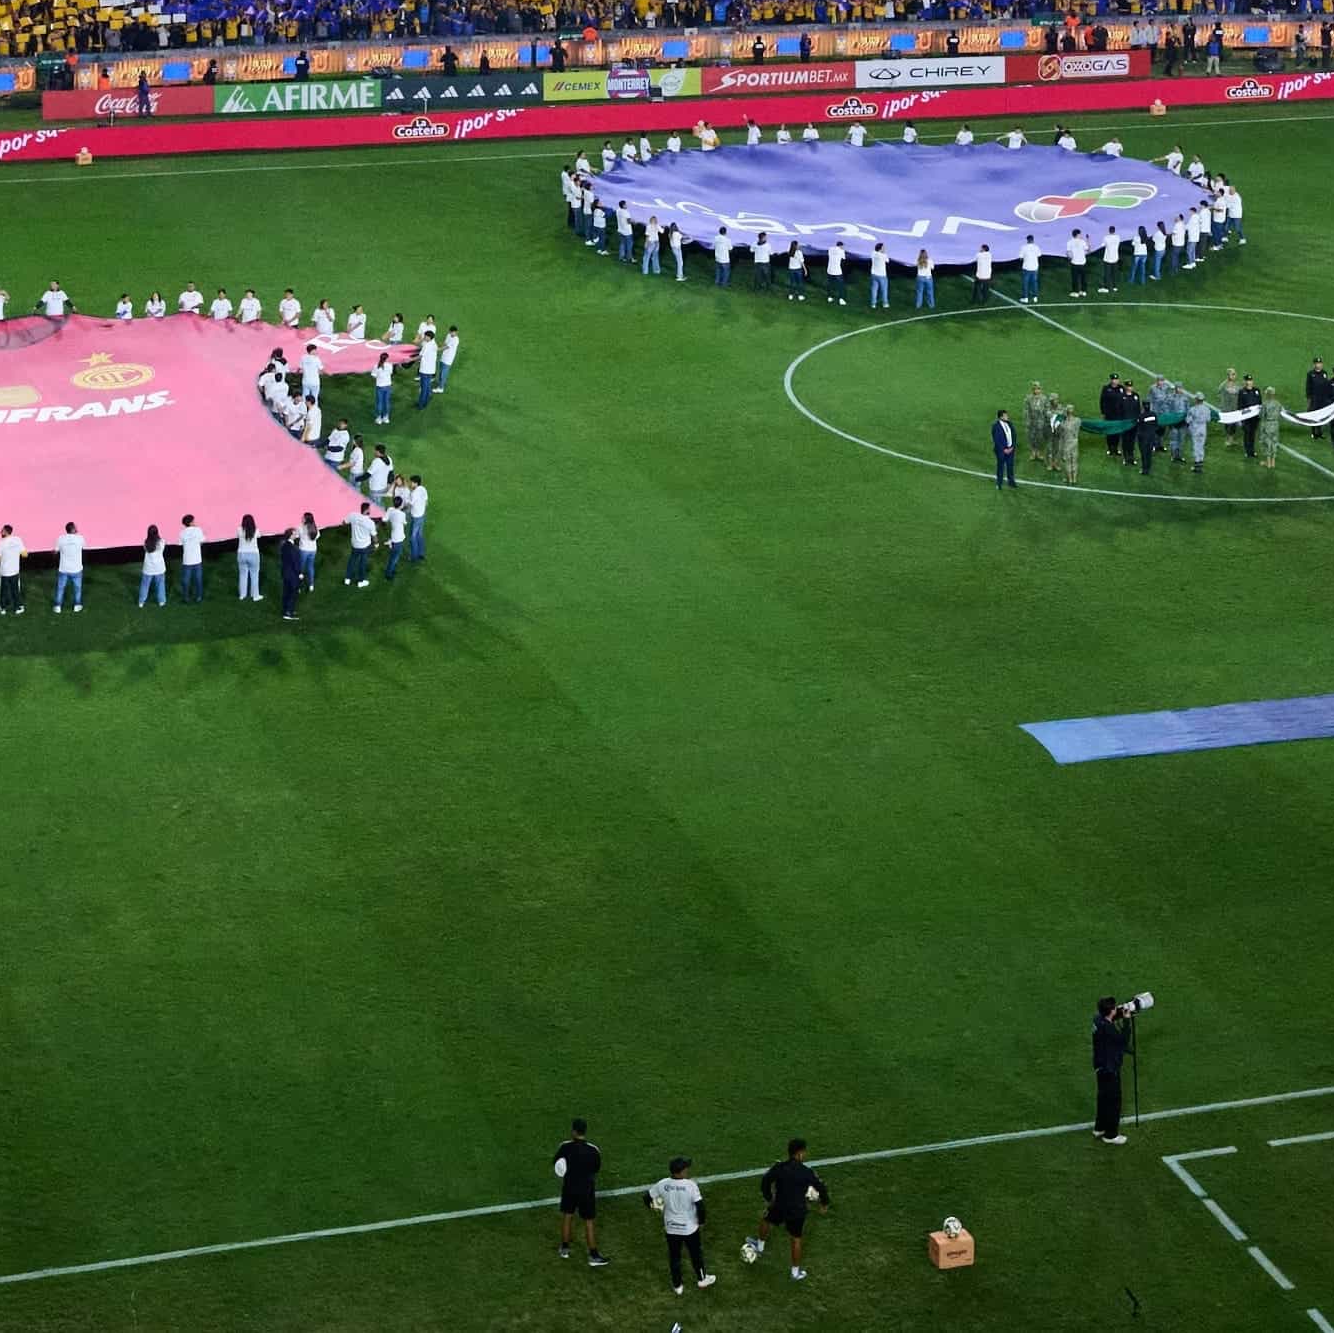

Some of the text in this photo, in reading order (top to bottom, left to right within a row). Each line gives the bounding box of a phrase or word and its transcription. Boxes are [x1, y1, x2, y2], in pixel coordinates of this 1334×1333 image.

[910, 64, 992, 78] CHIREY
[564, 81, 601, 91] CEMEX
[262, 82, 376, 113] AFIRME
